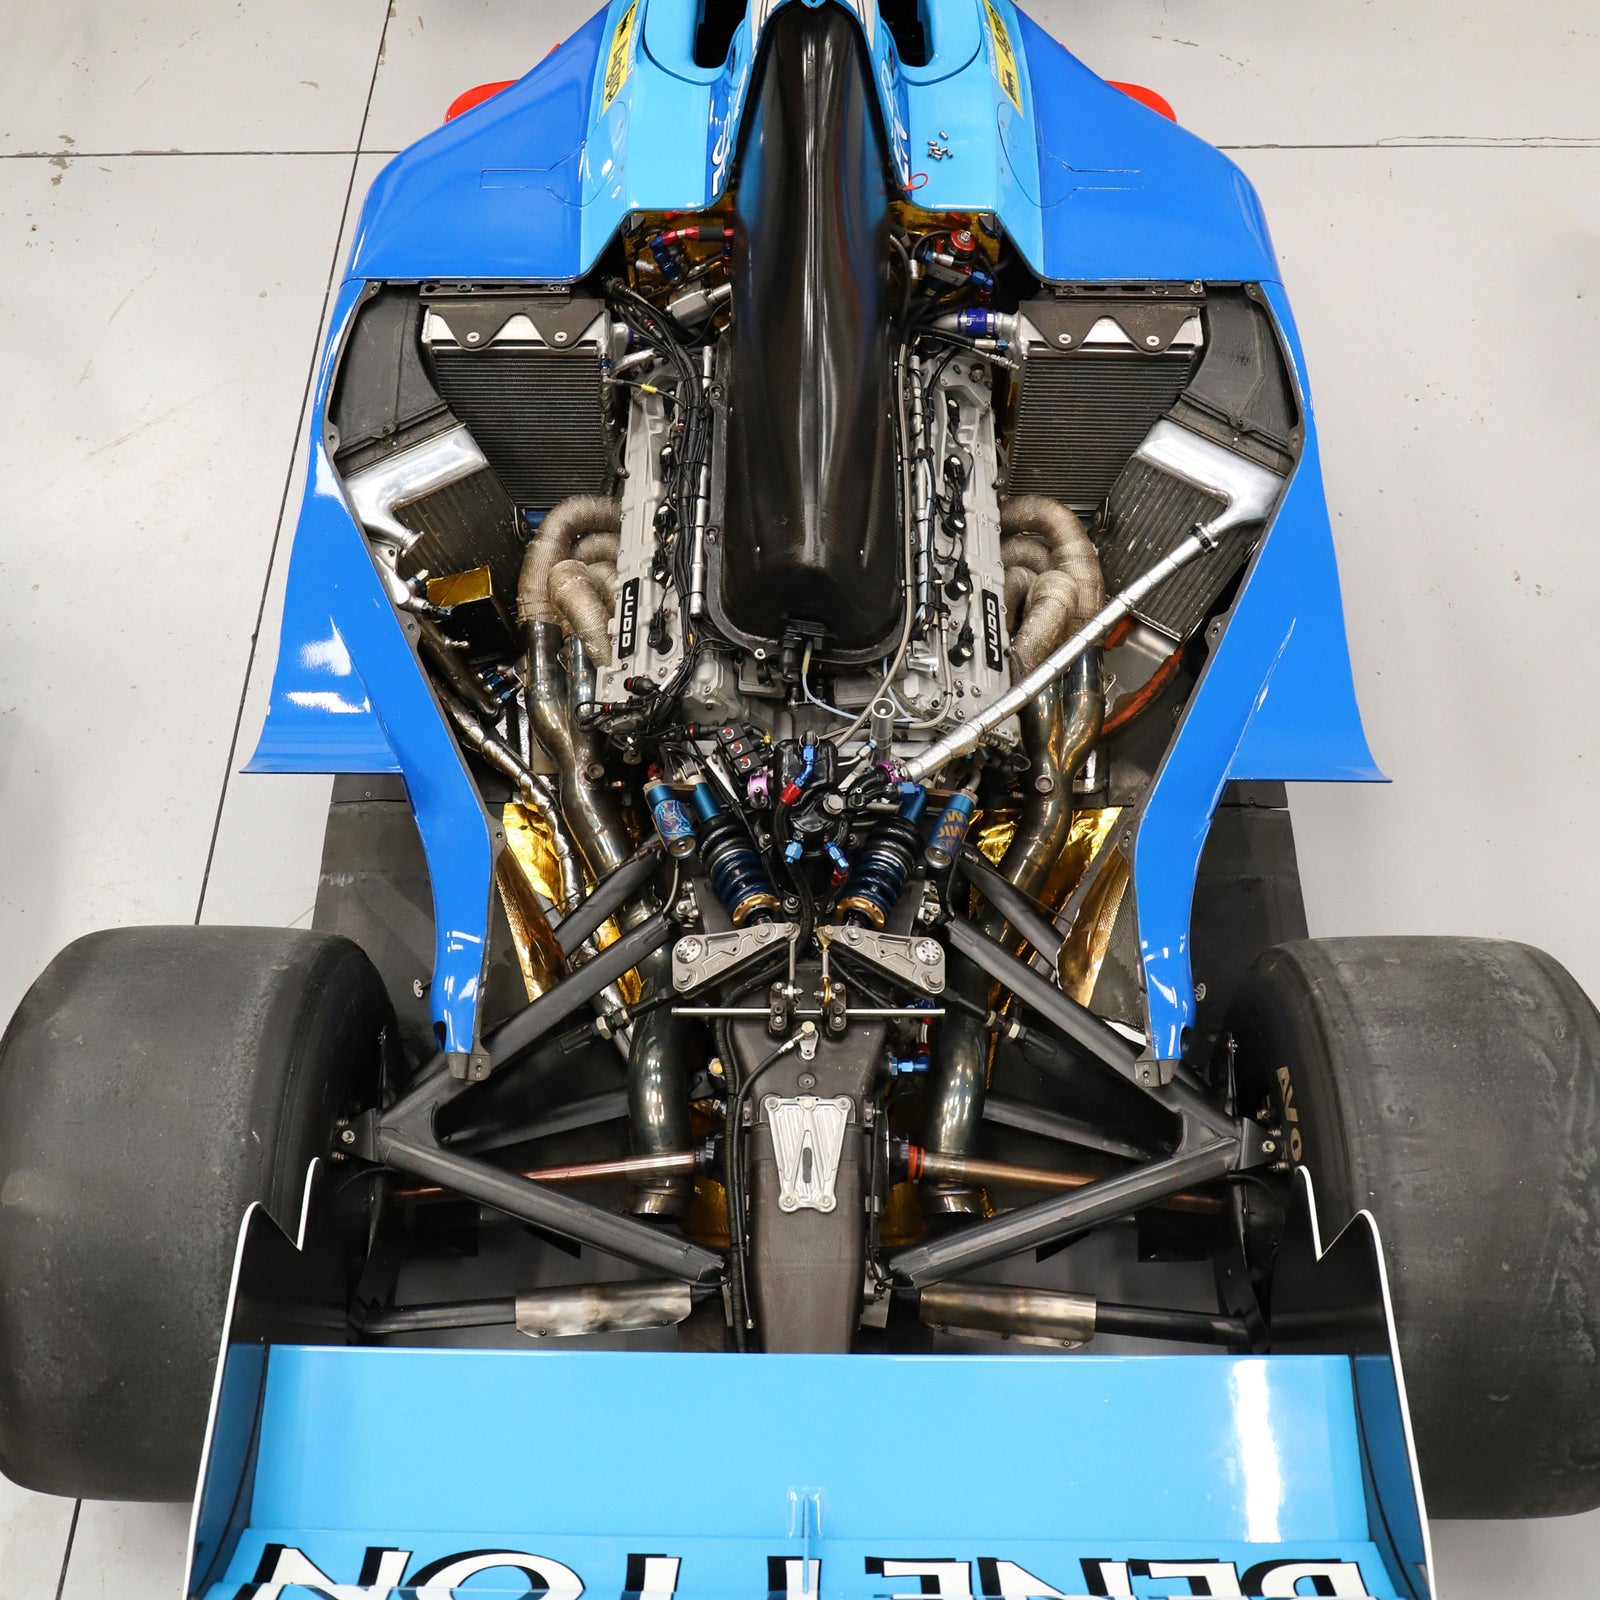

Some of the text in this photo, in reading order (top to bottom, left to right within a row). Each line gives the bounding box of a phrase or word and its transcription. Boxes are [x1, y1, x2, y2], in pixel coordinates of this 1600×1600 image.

[622, 587, 634, 648] JUDD
[986, 598, 1000, 662] JUDD
[1276, 1066, 1303, 1162] AVO
